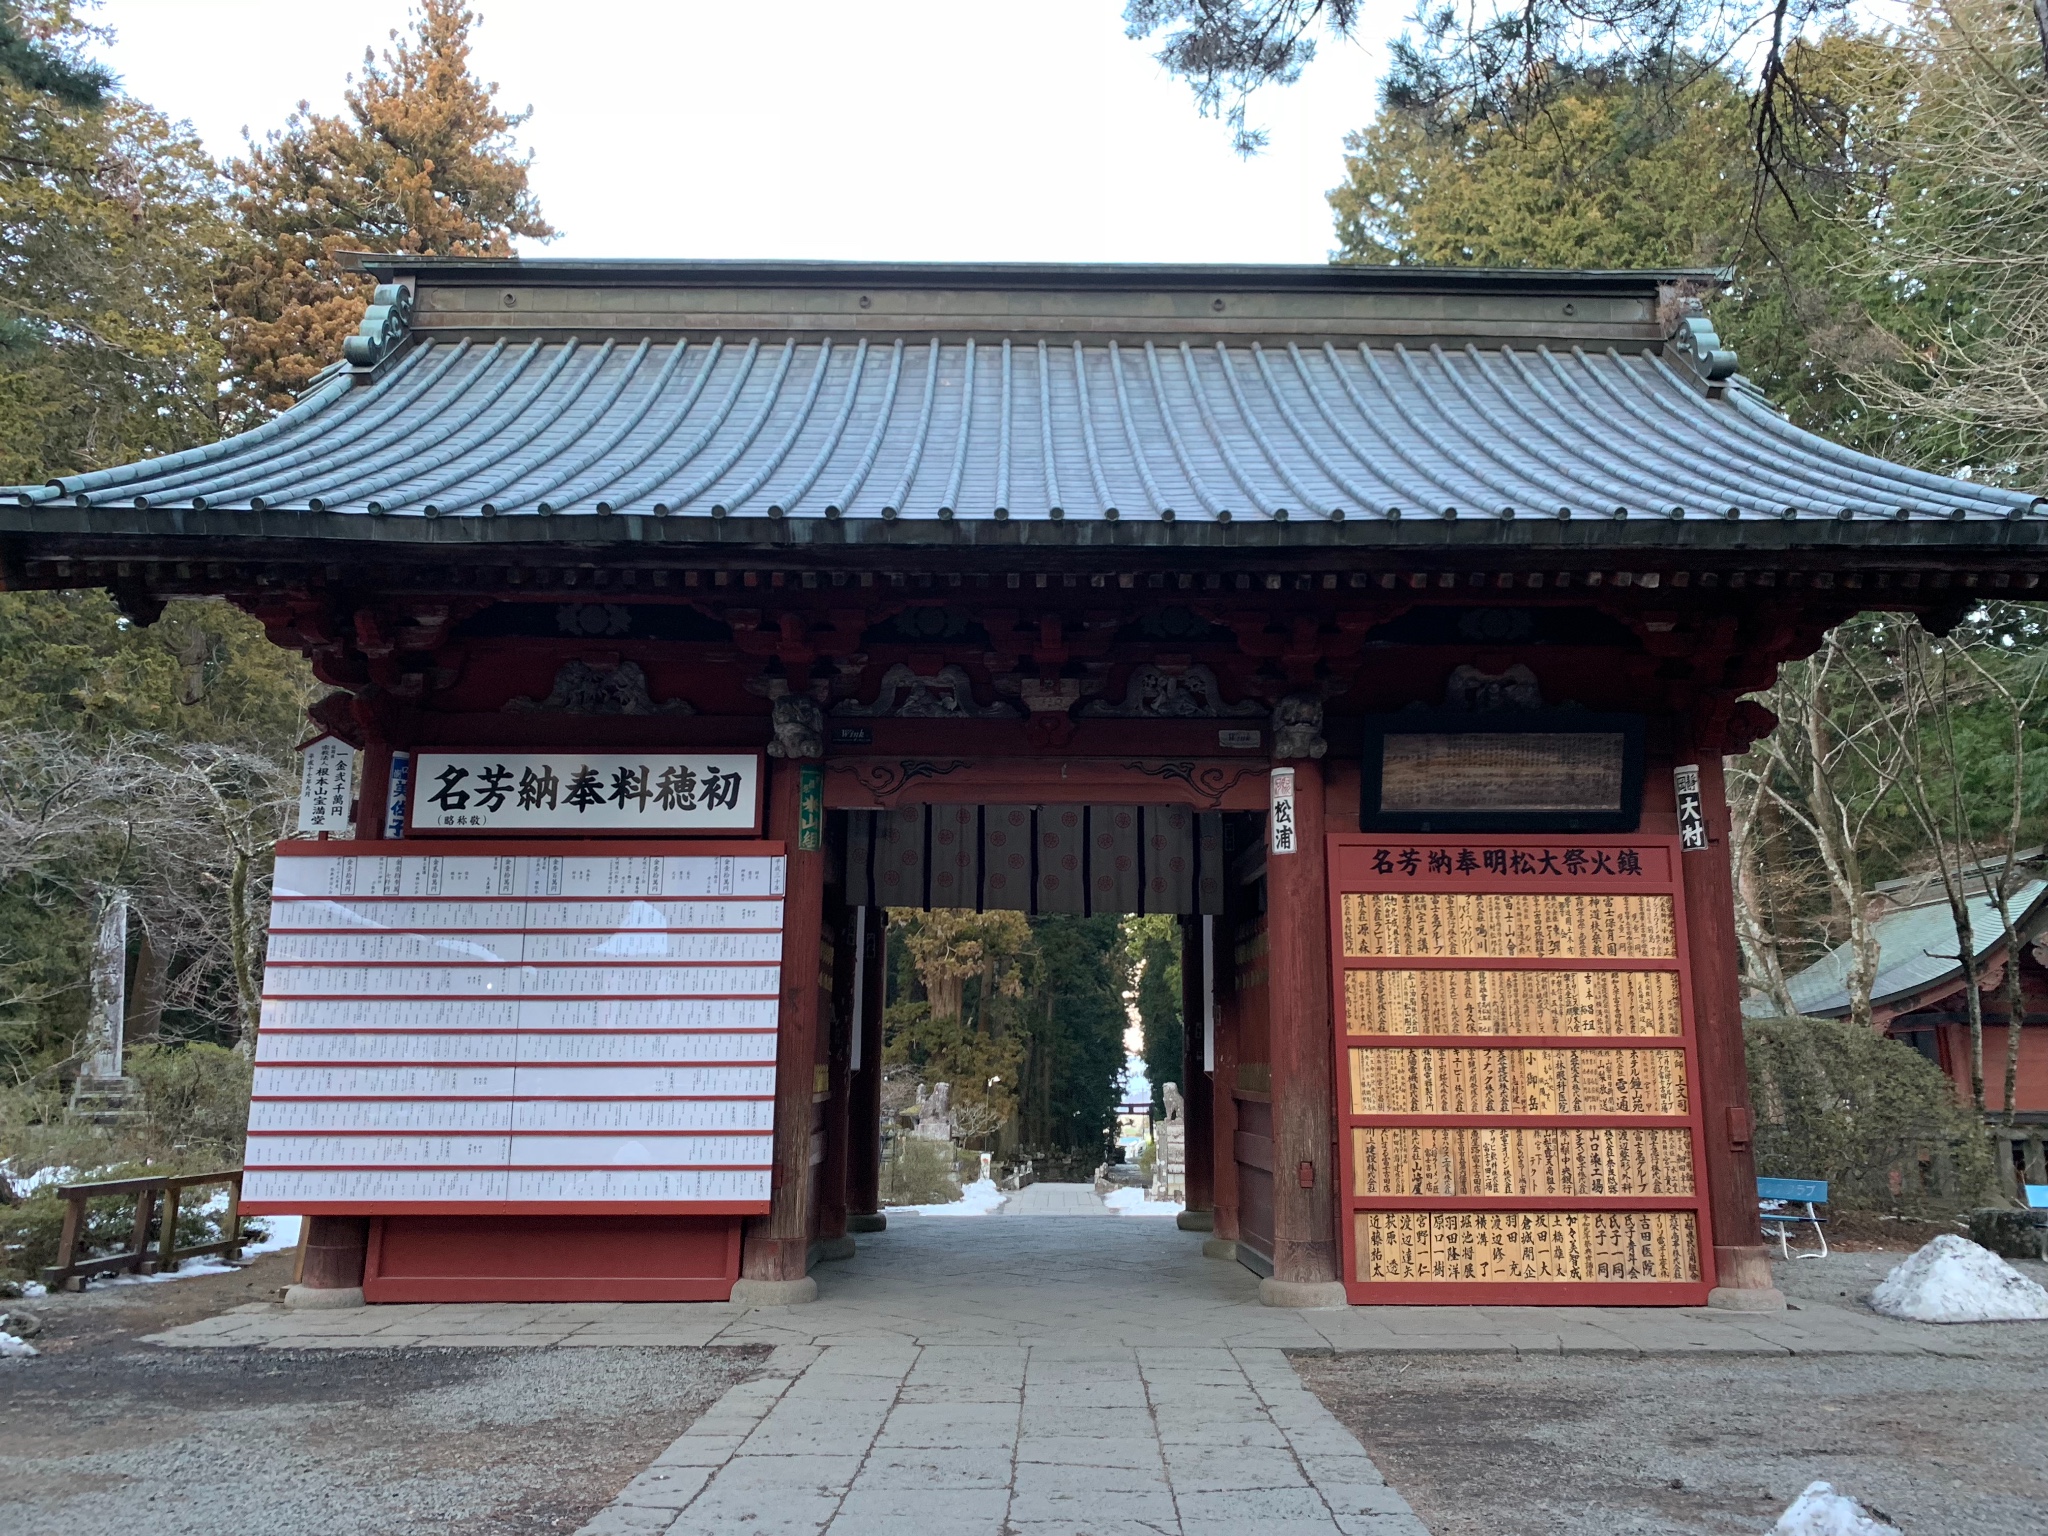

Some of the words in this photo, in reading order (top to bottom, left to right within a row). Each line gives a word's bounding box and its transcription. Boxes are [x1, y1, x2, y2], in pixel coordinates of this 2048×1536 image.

[426, 763, 743, 814] 初穂料奉納芳名
[1274, 799, 1294, 850] 松浦
[1680, 796, 1703, 846] 大村
[1370, 847, 1643, 877] 鎮火祭大松明奉納芳名
[1603, 896, 1617, 956] 富士保育園
[1525, 1052, 1538, 1111] 小御岳
[1616, 1050, 1630, 1112] 株式会社電通
[1619, 1129, 1632, 1194] 渡辺整形外科
[1633, 1129, 1647, 1193] 富士急グループ
[1400, 1214, 1414, 1278] 渡辺達矢
[1416, 1214, 1430, 1276] 宮野一仁
[1433, 1215, 1444, 1277] 原口一樹
[1445, 1216, 1460, 1279] 羽田隆洋
[1474, 1215, 1488, 1277] 横溝了
[1490, 1215, 1505, 1273] 渡辺修一
[1505, 1215, 1521, 1276] 羽田充
[1535, 1215, 1551, 1276] 坂田一大
[1551, 1215, 1566, 1277] 土橋雄太
[1566, 1215, 1581, 1280] 加々美智成
[1595, 1214, 1609, 1278] 氏子一同
[1609, 1214, 1624, 1279] 氏子一同
[1624, 1214, 1640, 1279] 氏子青年会
[1640, 1215, 1656, 1277] 吉田医院
